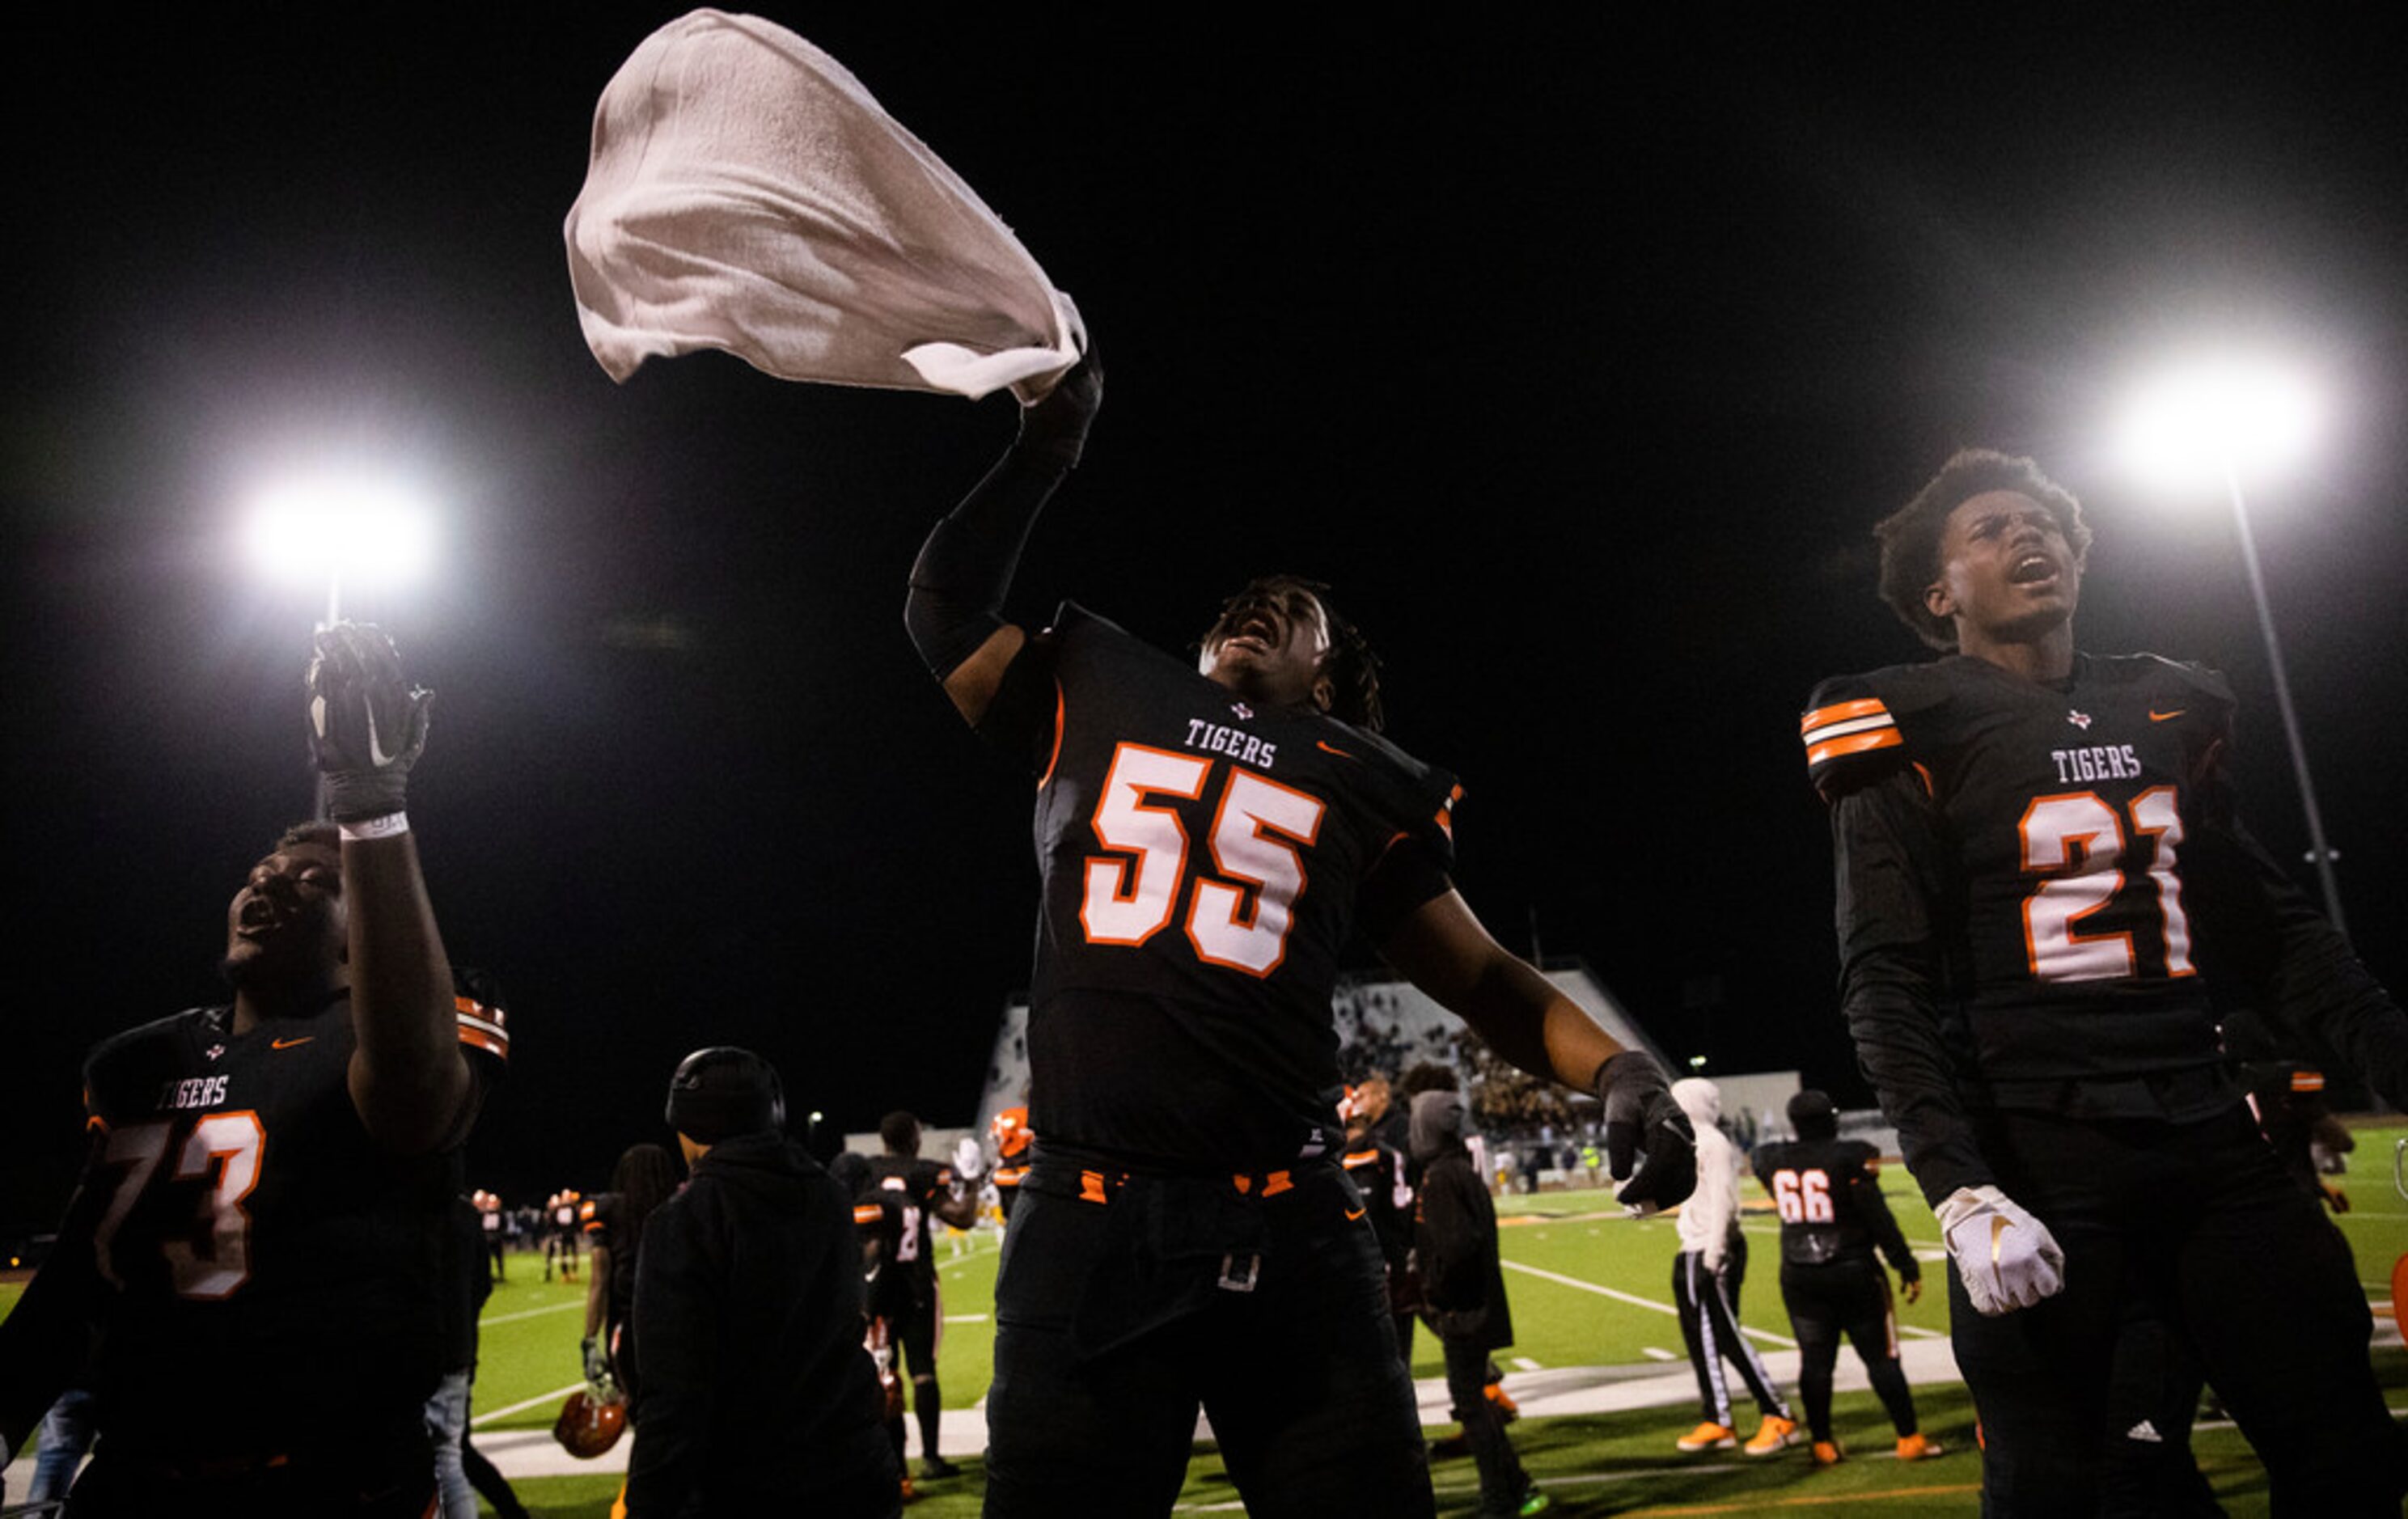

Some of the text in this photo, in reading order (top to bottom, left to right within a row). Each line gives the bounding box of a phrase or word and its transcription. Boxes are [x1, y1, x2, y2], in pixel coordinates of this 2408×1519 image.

[1184, 718, 1277, 768] TIGERS
[2051, 744, 2141, 783] TIGERS
[1078, 740, 1328, 980] 55
[2017, 785, 2198, 984] 21
[92, 1109, 268, 1303] 73
[1772, 1169, 1835, 1224] 66
